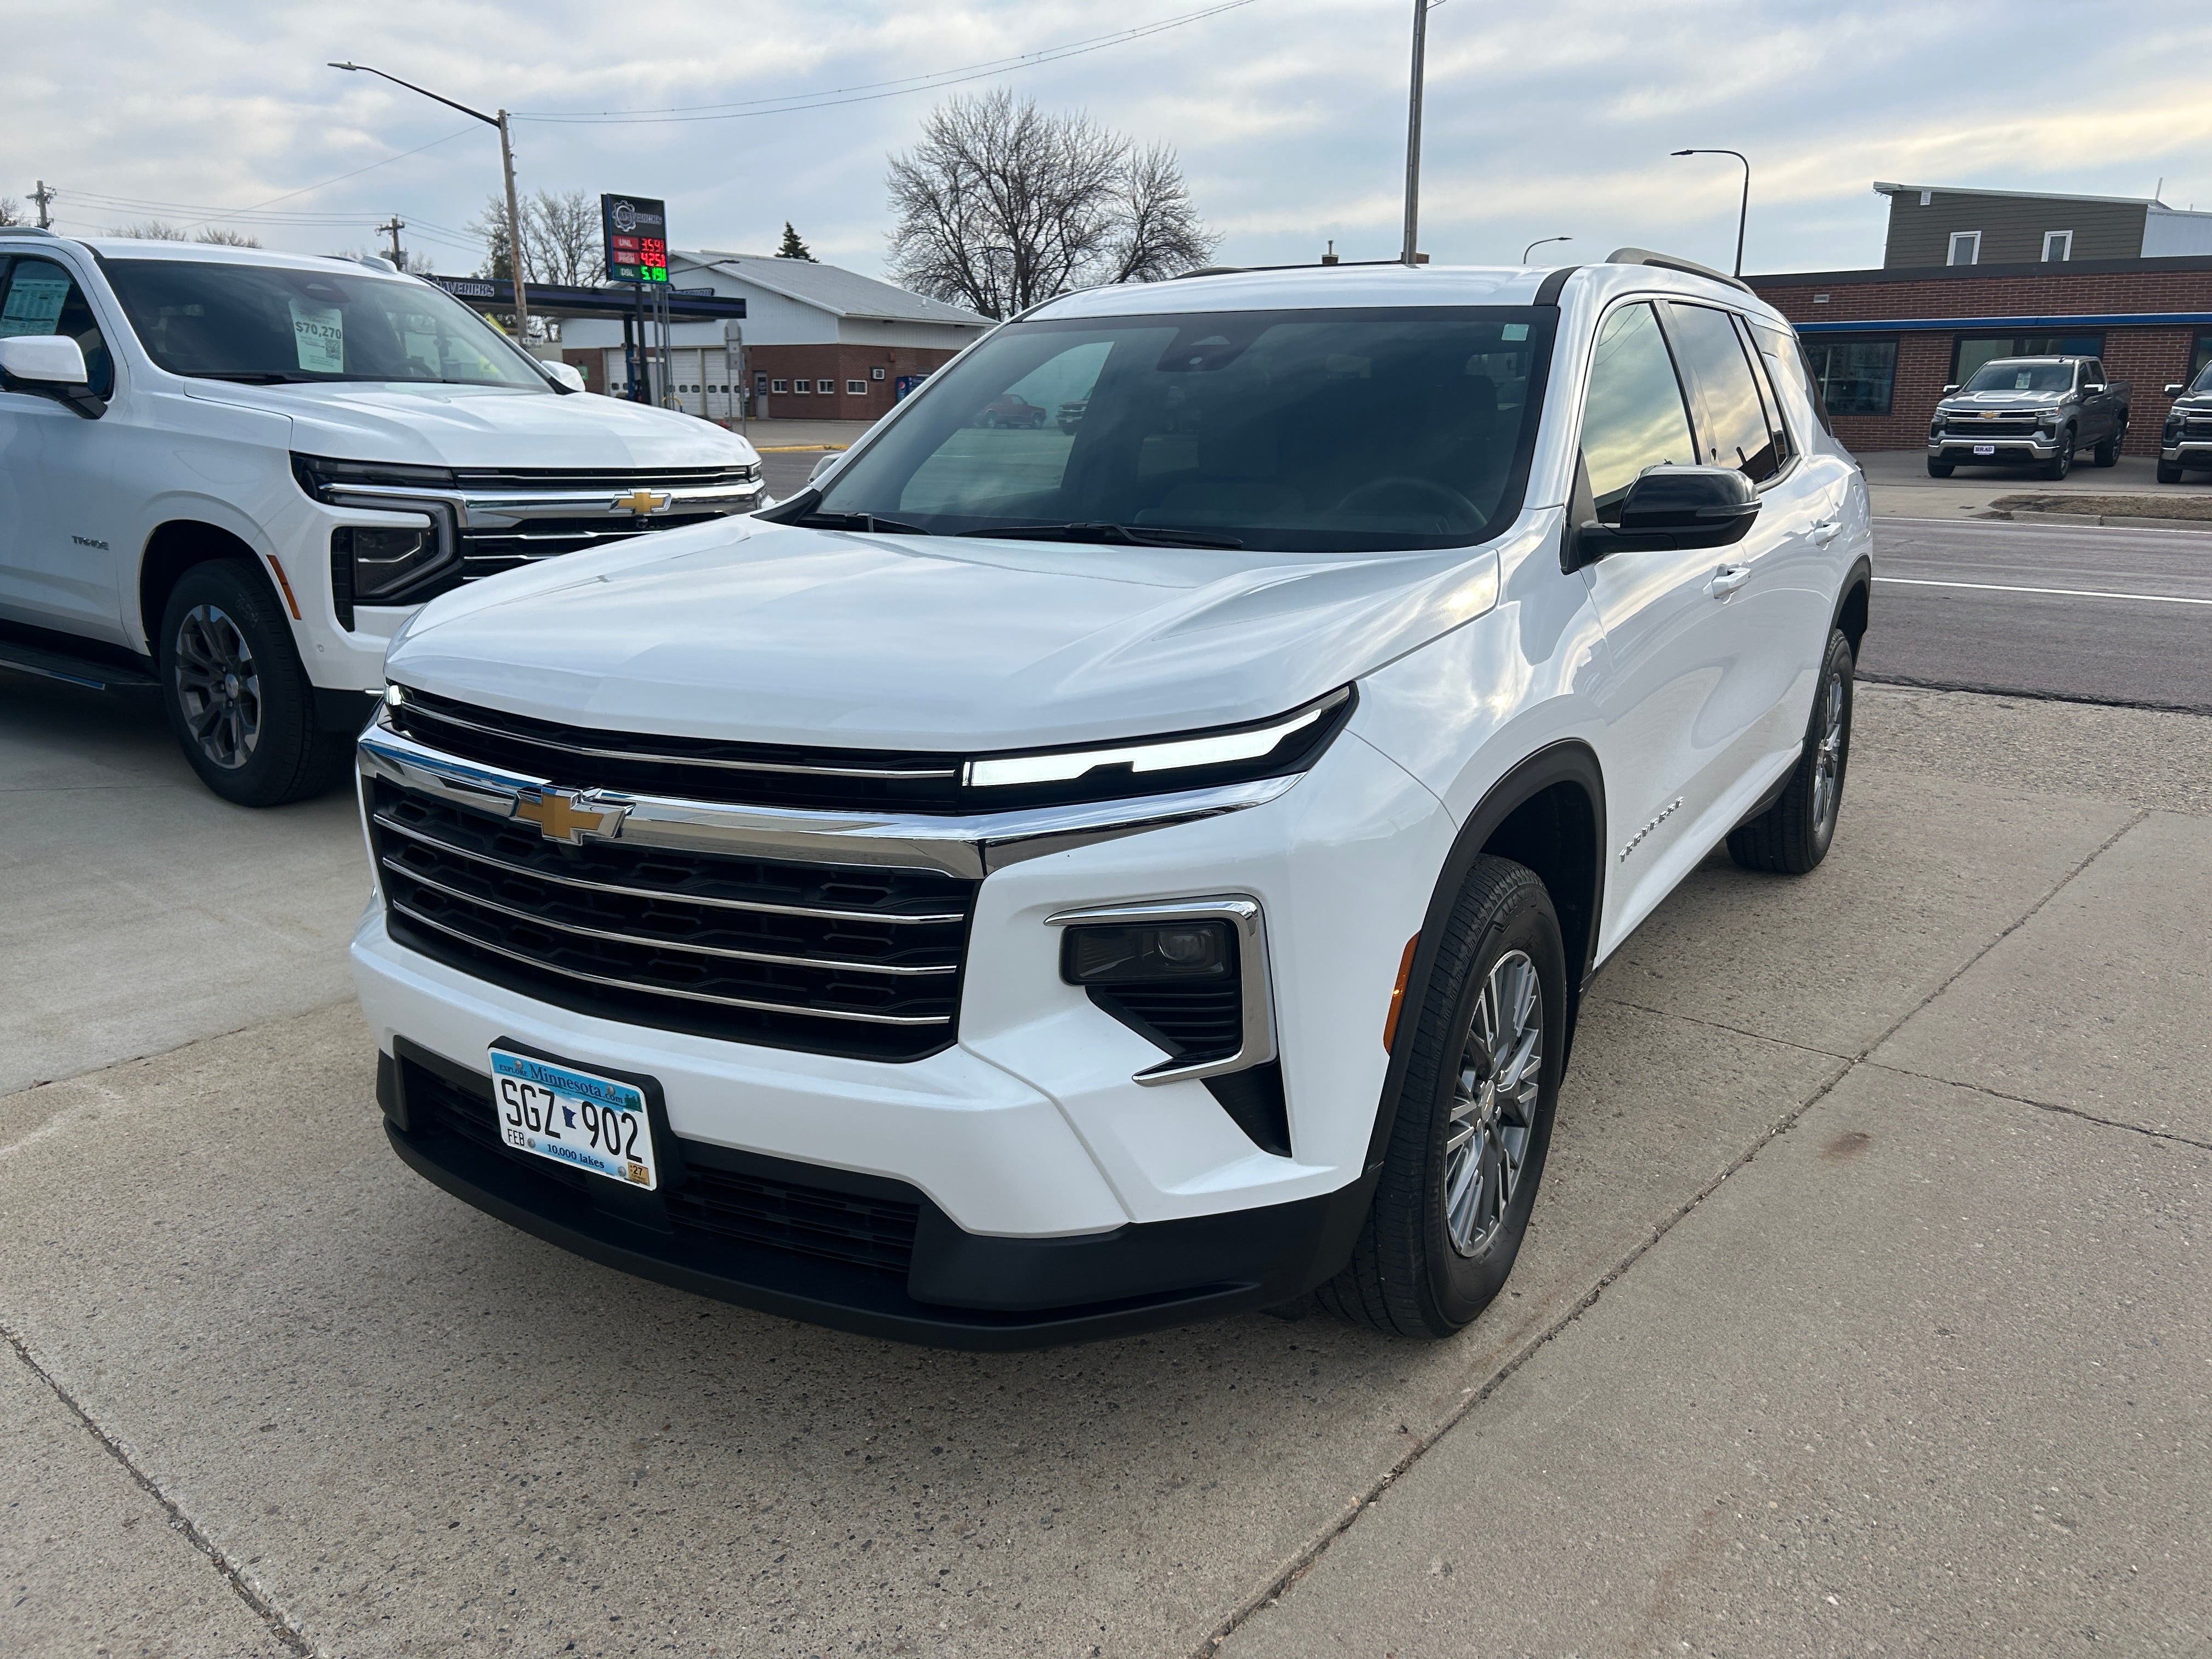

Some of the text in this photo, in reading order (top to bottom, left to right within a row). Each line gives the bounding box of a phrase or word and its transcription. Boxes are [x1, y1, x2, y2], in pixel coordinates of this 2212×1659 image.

[295, 321, 342, 340] $70,270
[499, 1064, 528, 1076] EXPLORE
[501, 1078, 643, 1164] SGZ 902
[507, 1128, 525, 1146] FEB
[547, 1143, 605, 1169] 10,000 lakes
[633, 1165, 643, 1176] 27
